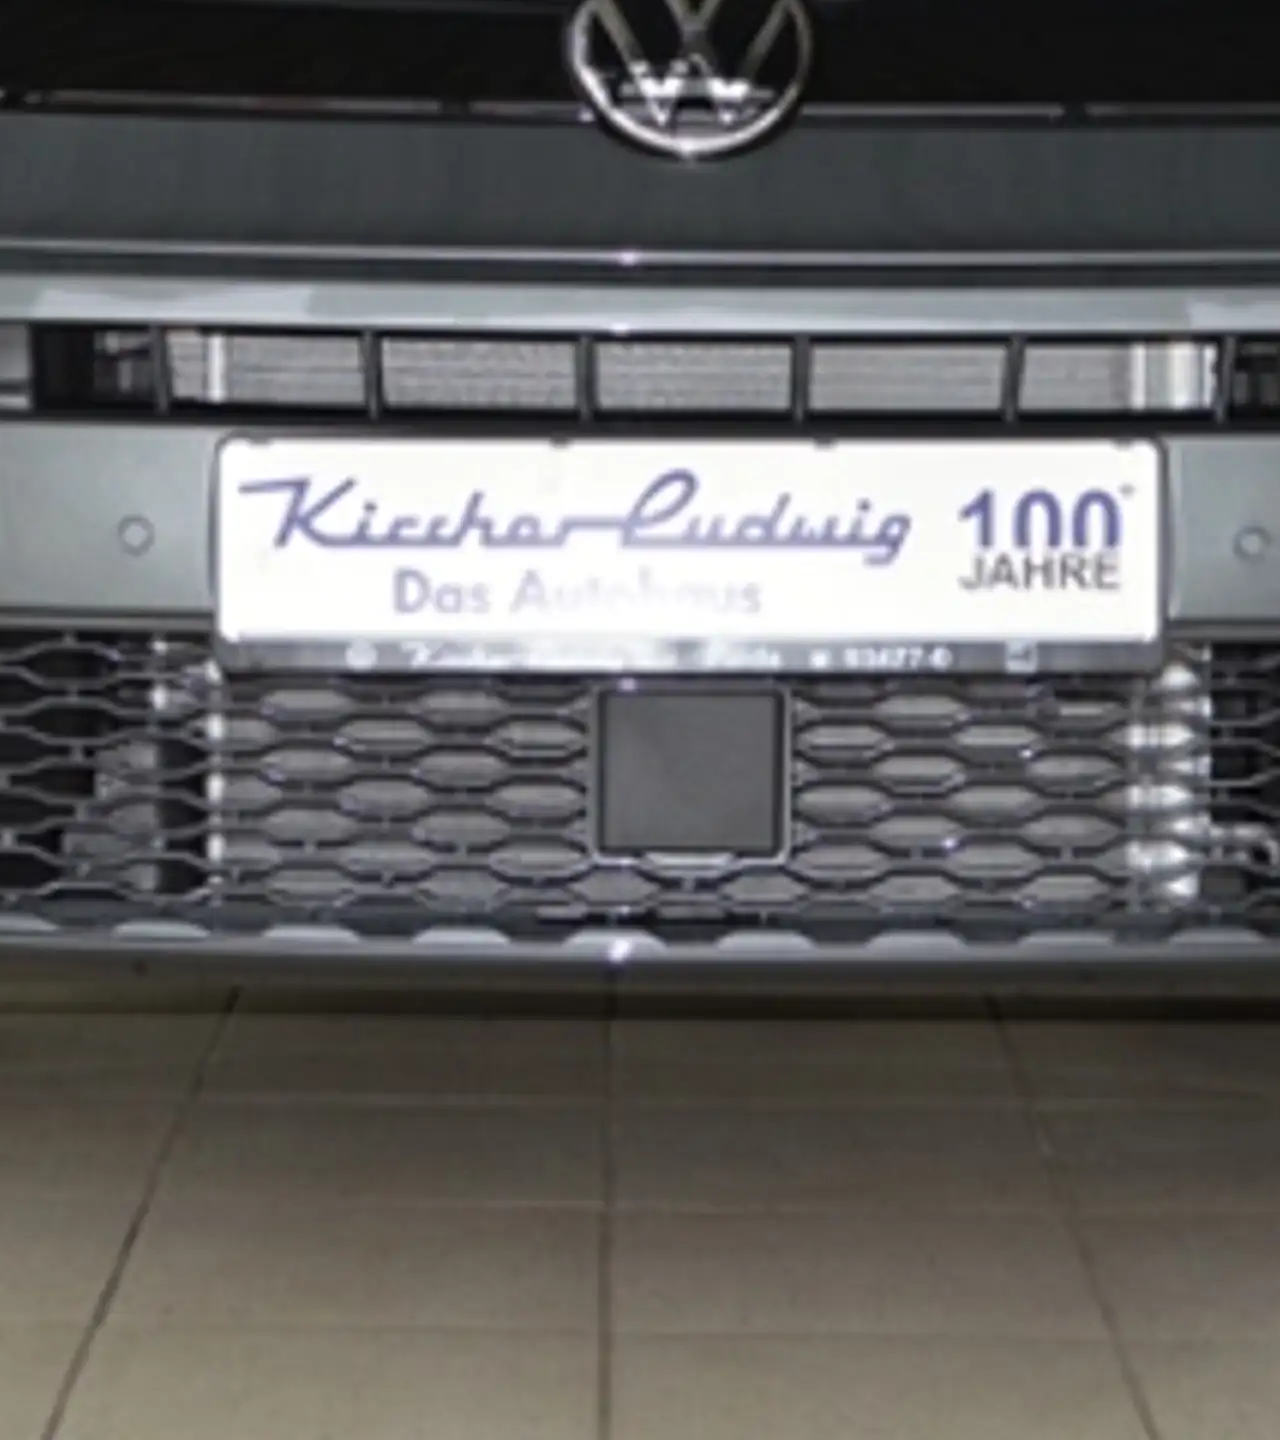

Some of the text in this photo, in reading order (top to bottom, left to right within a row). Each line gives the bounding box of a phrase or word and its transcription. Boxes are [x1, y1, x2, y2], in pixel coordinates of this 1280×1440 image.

[959, 487, 1120, 549] 100
[392, 566, 490, 614] Das
[957, 552, 1122, 591] JAHRE
